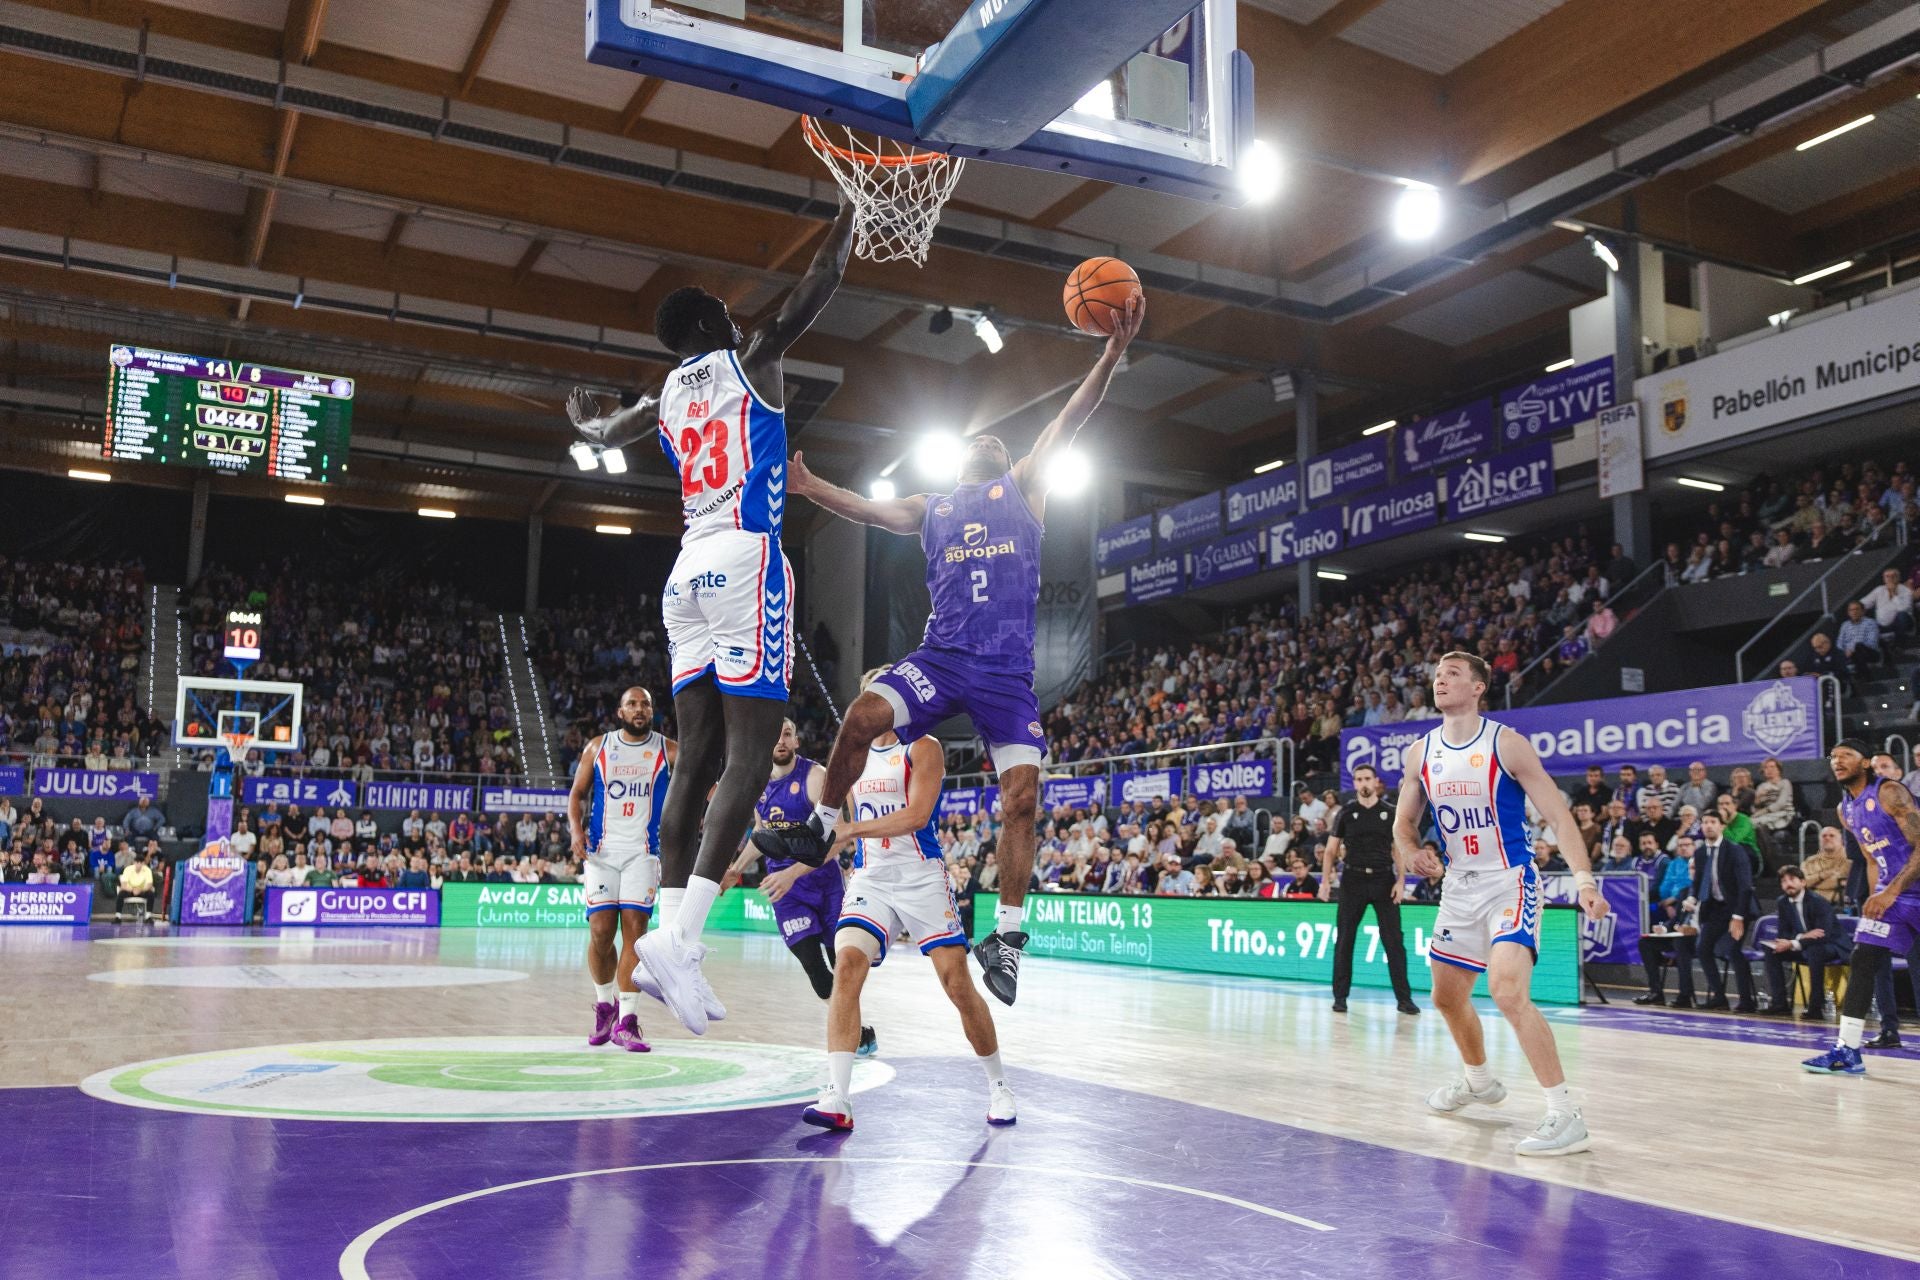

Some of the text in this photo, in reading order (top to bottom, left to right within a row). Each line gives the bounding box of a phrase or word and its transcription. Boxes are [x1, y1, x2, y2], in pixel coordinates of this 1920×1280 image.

[206, 361, 226, 378] 14
[1713, 342, 1920, 420] Pabellón Municipa
[223, 386, 244, 401] 1Q
[1548, 381, 1612, 424] LYVE
[205, 408, 259, 430] 04:44
[1600, 405, 1636, 426] RIFA
[208, 435, 218, 449] 3
[240, 439, 250, 453] 3
[680, 424, 729, 498] 23
[1378, 492, 1435, 524] nirosa
[945, 541, 1015, 563] agropal
[970, 570, 989, 603] 2
[231, 628, 258, 648] 10
[893, 660, 937, 702] gaza
[1530, 708, 1731, 760] palencia
[39, 772, 118, 796] JULUIS
[1211, 764, 1266, 790] soltec
[368, 785, 471, 811] CLÍNICA RENÉ
[630, 782, 650, 798] HLA
[1436, 780, 1481, 797] LUCENTUM
[622, 802, 635, 817] 13
[1464, 805, 1496, 829] HLA
[1463, 834, 1479, 856] 15
[10, 892, 77, 904] HERRERO
[321, 891, 427, 914] Grupo CFI
[478, 886, 541, 906] Avda/
[547, 887, 586, 906] SAN
[9, 904, 64, 916] SOBRIN
[477, 907, 586, 926] (Junto Hospit
[1036, 899, 1064, 923] SAN
[1069, 900, 1125, 930] TELMO,
[1132, 903, 1153, 928] 13
[1029, 929, 1153, 963] Hospital San Telmo)
[1207, 918, 1286, 957] Tfno.:
